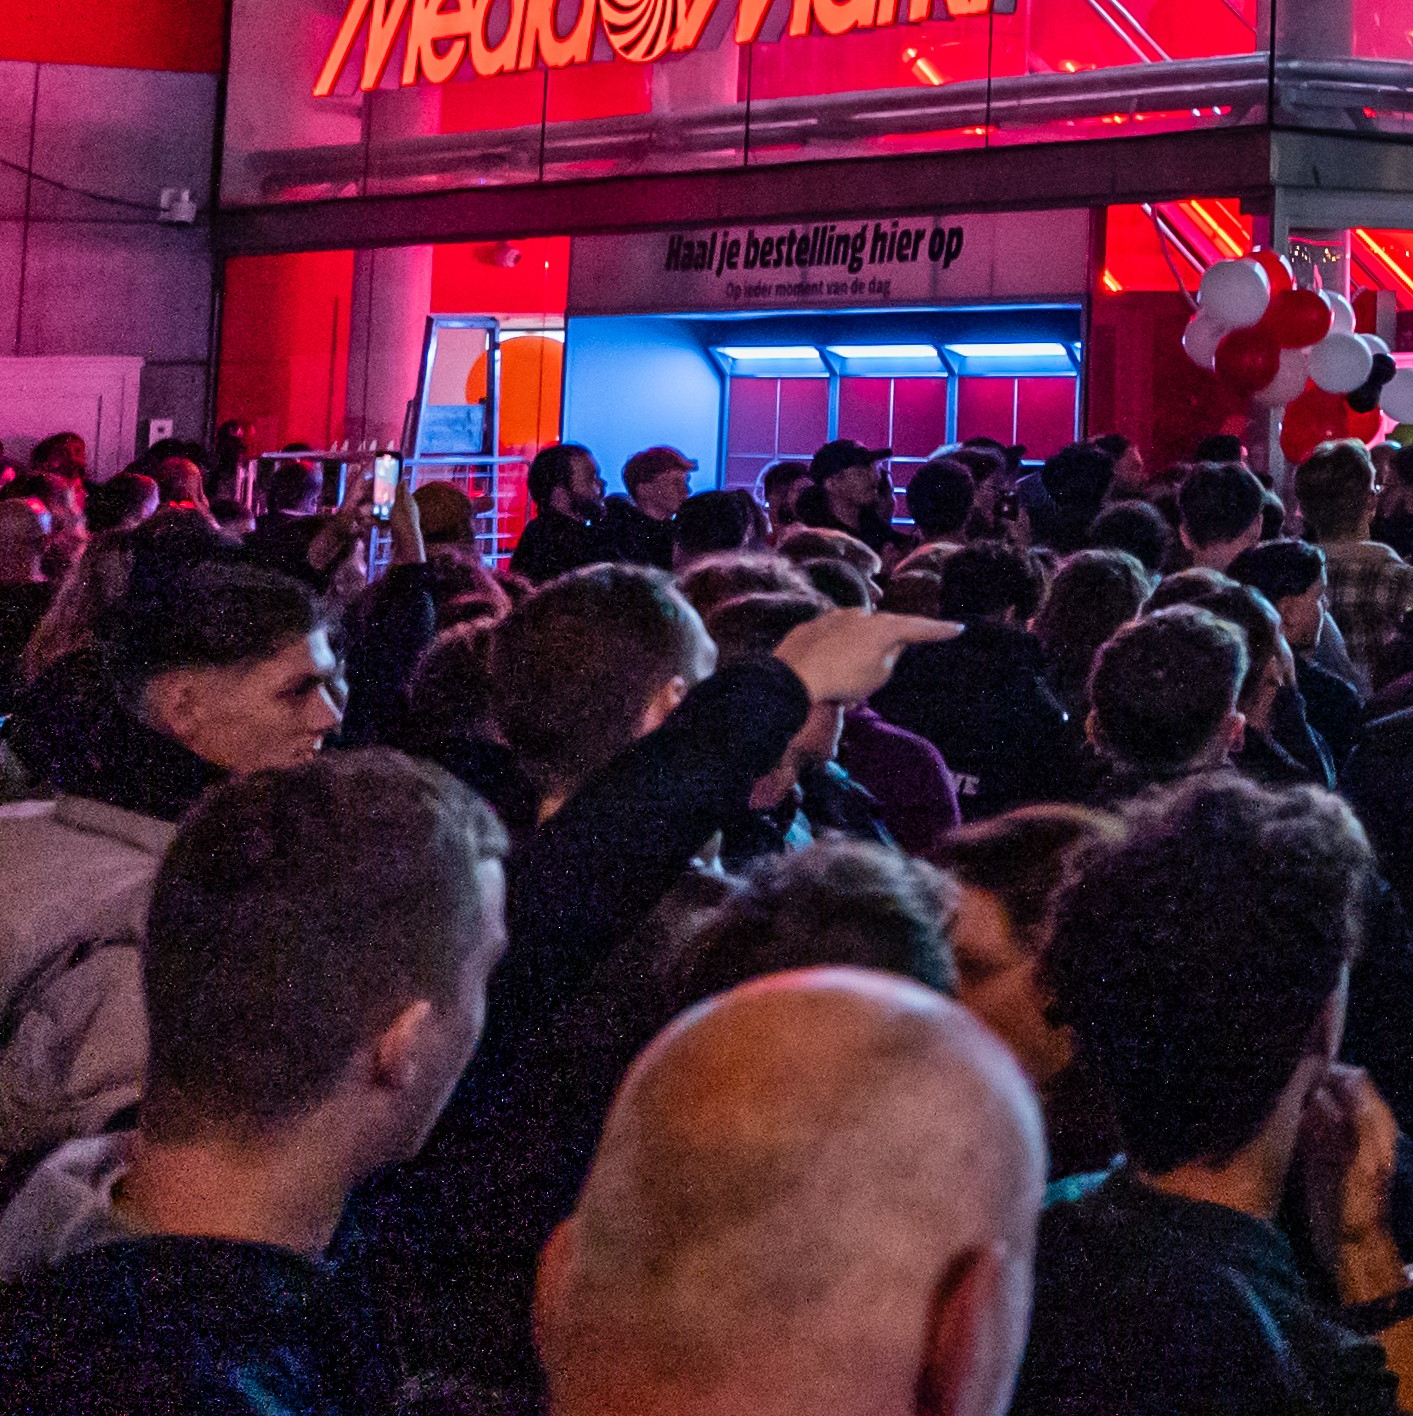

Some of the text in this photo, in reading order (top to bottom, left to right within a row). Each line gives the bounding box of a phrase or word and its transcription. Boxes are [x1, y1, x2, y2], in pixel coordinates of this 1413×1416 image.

[664, 220, 964, 278] Haal je bestelling hier op
